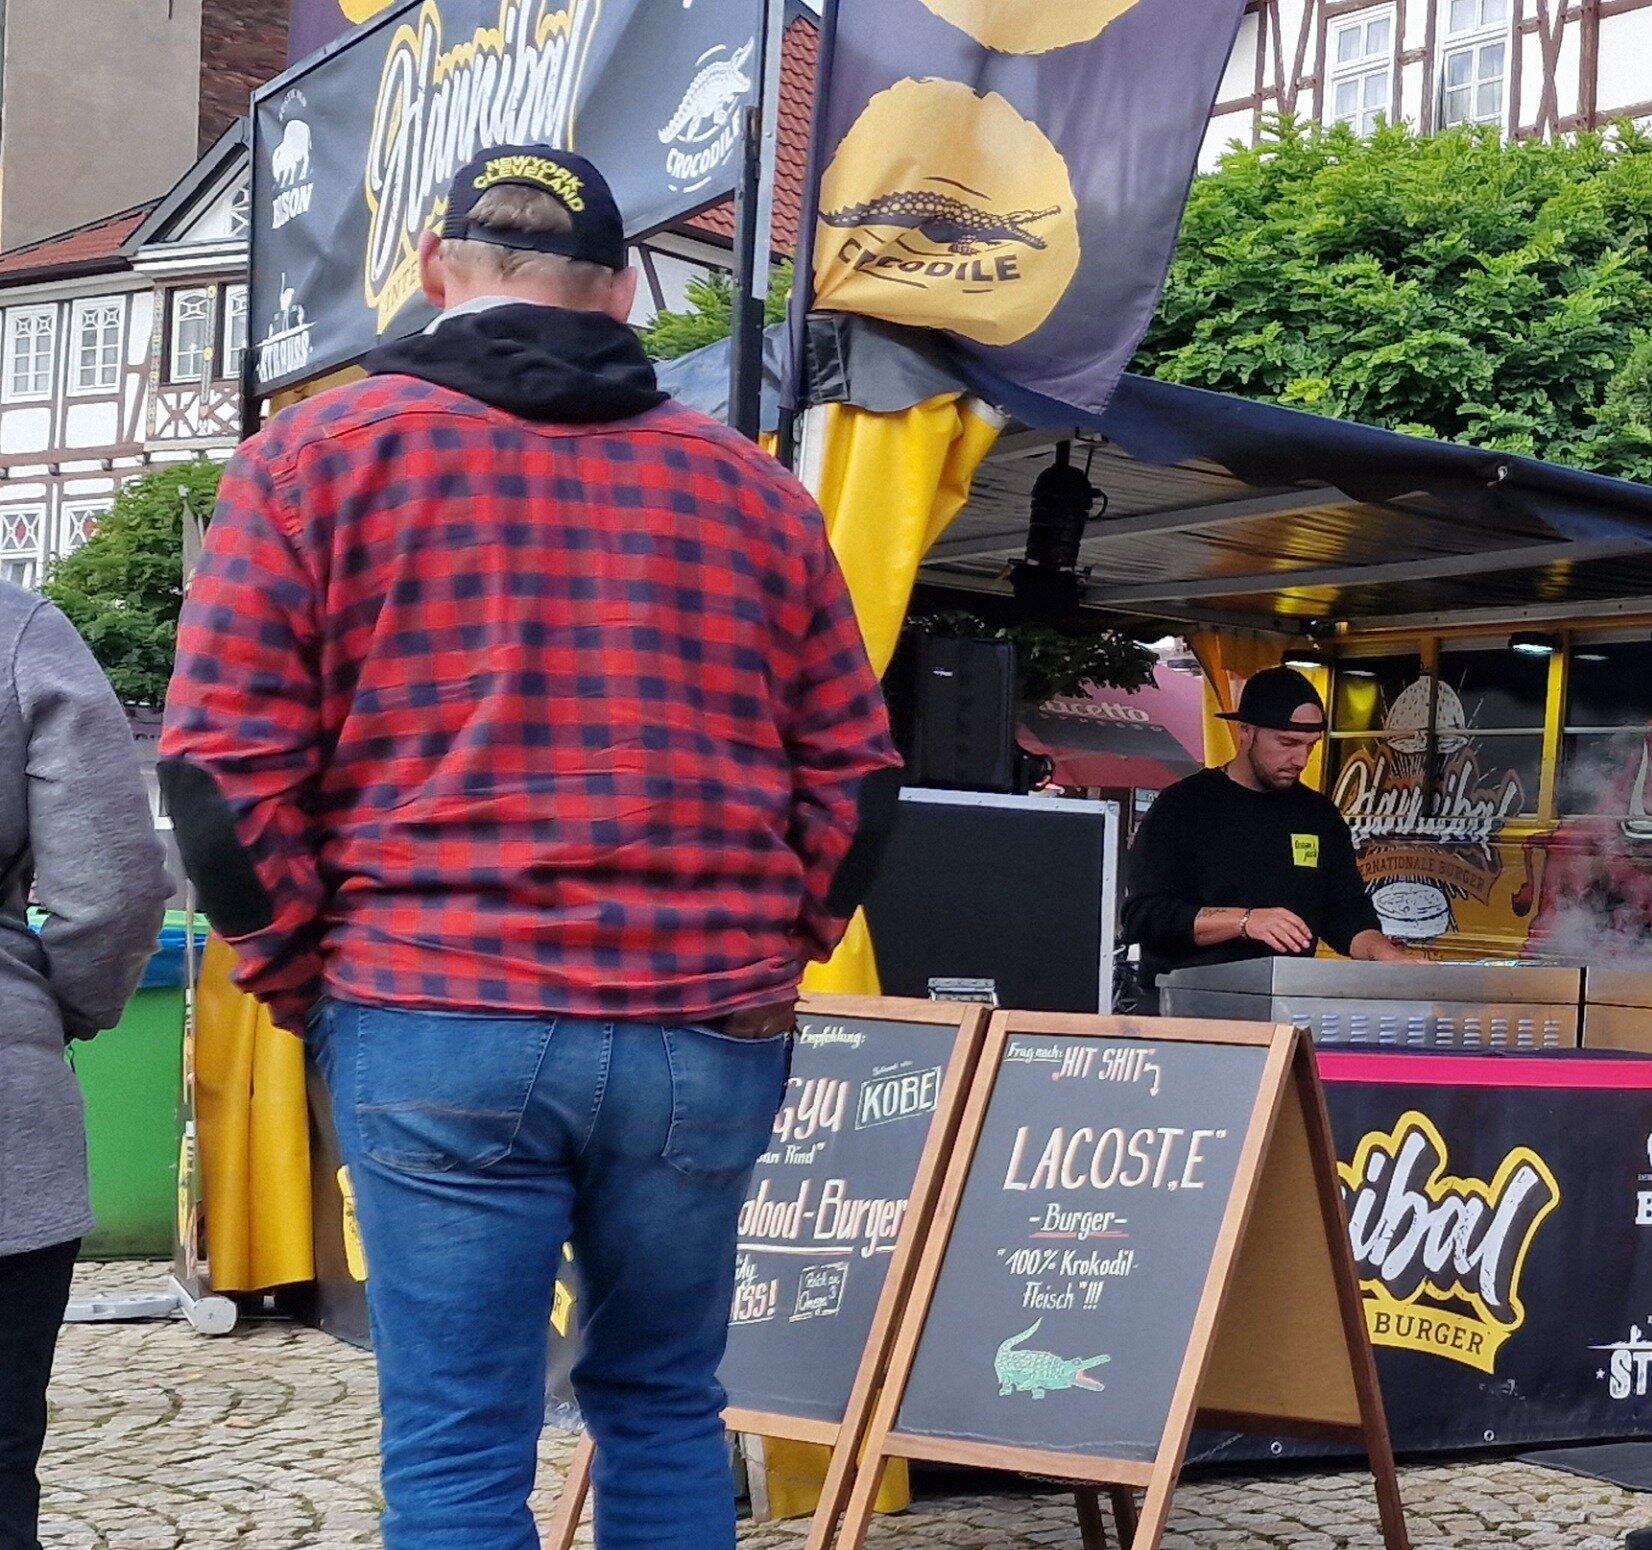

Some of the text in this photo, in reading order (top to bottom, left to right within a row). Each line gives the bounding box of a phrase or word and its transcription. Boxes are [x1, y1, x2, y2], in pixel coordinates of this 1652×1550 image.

[472, 165, 586, 213] CLEVELAND
[861, 1071, 937, 1124] KOBE
[1373, 1311, 1485, 1355] BURGER
